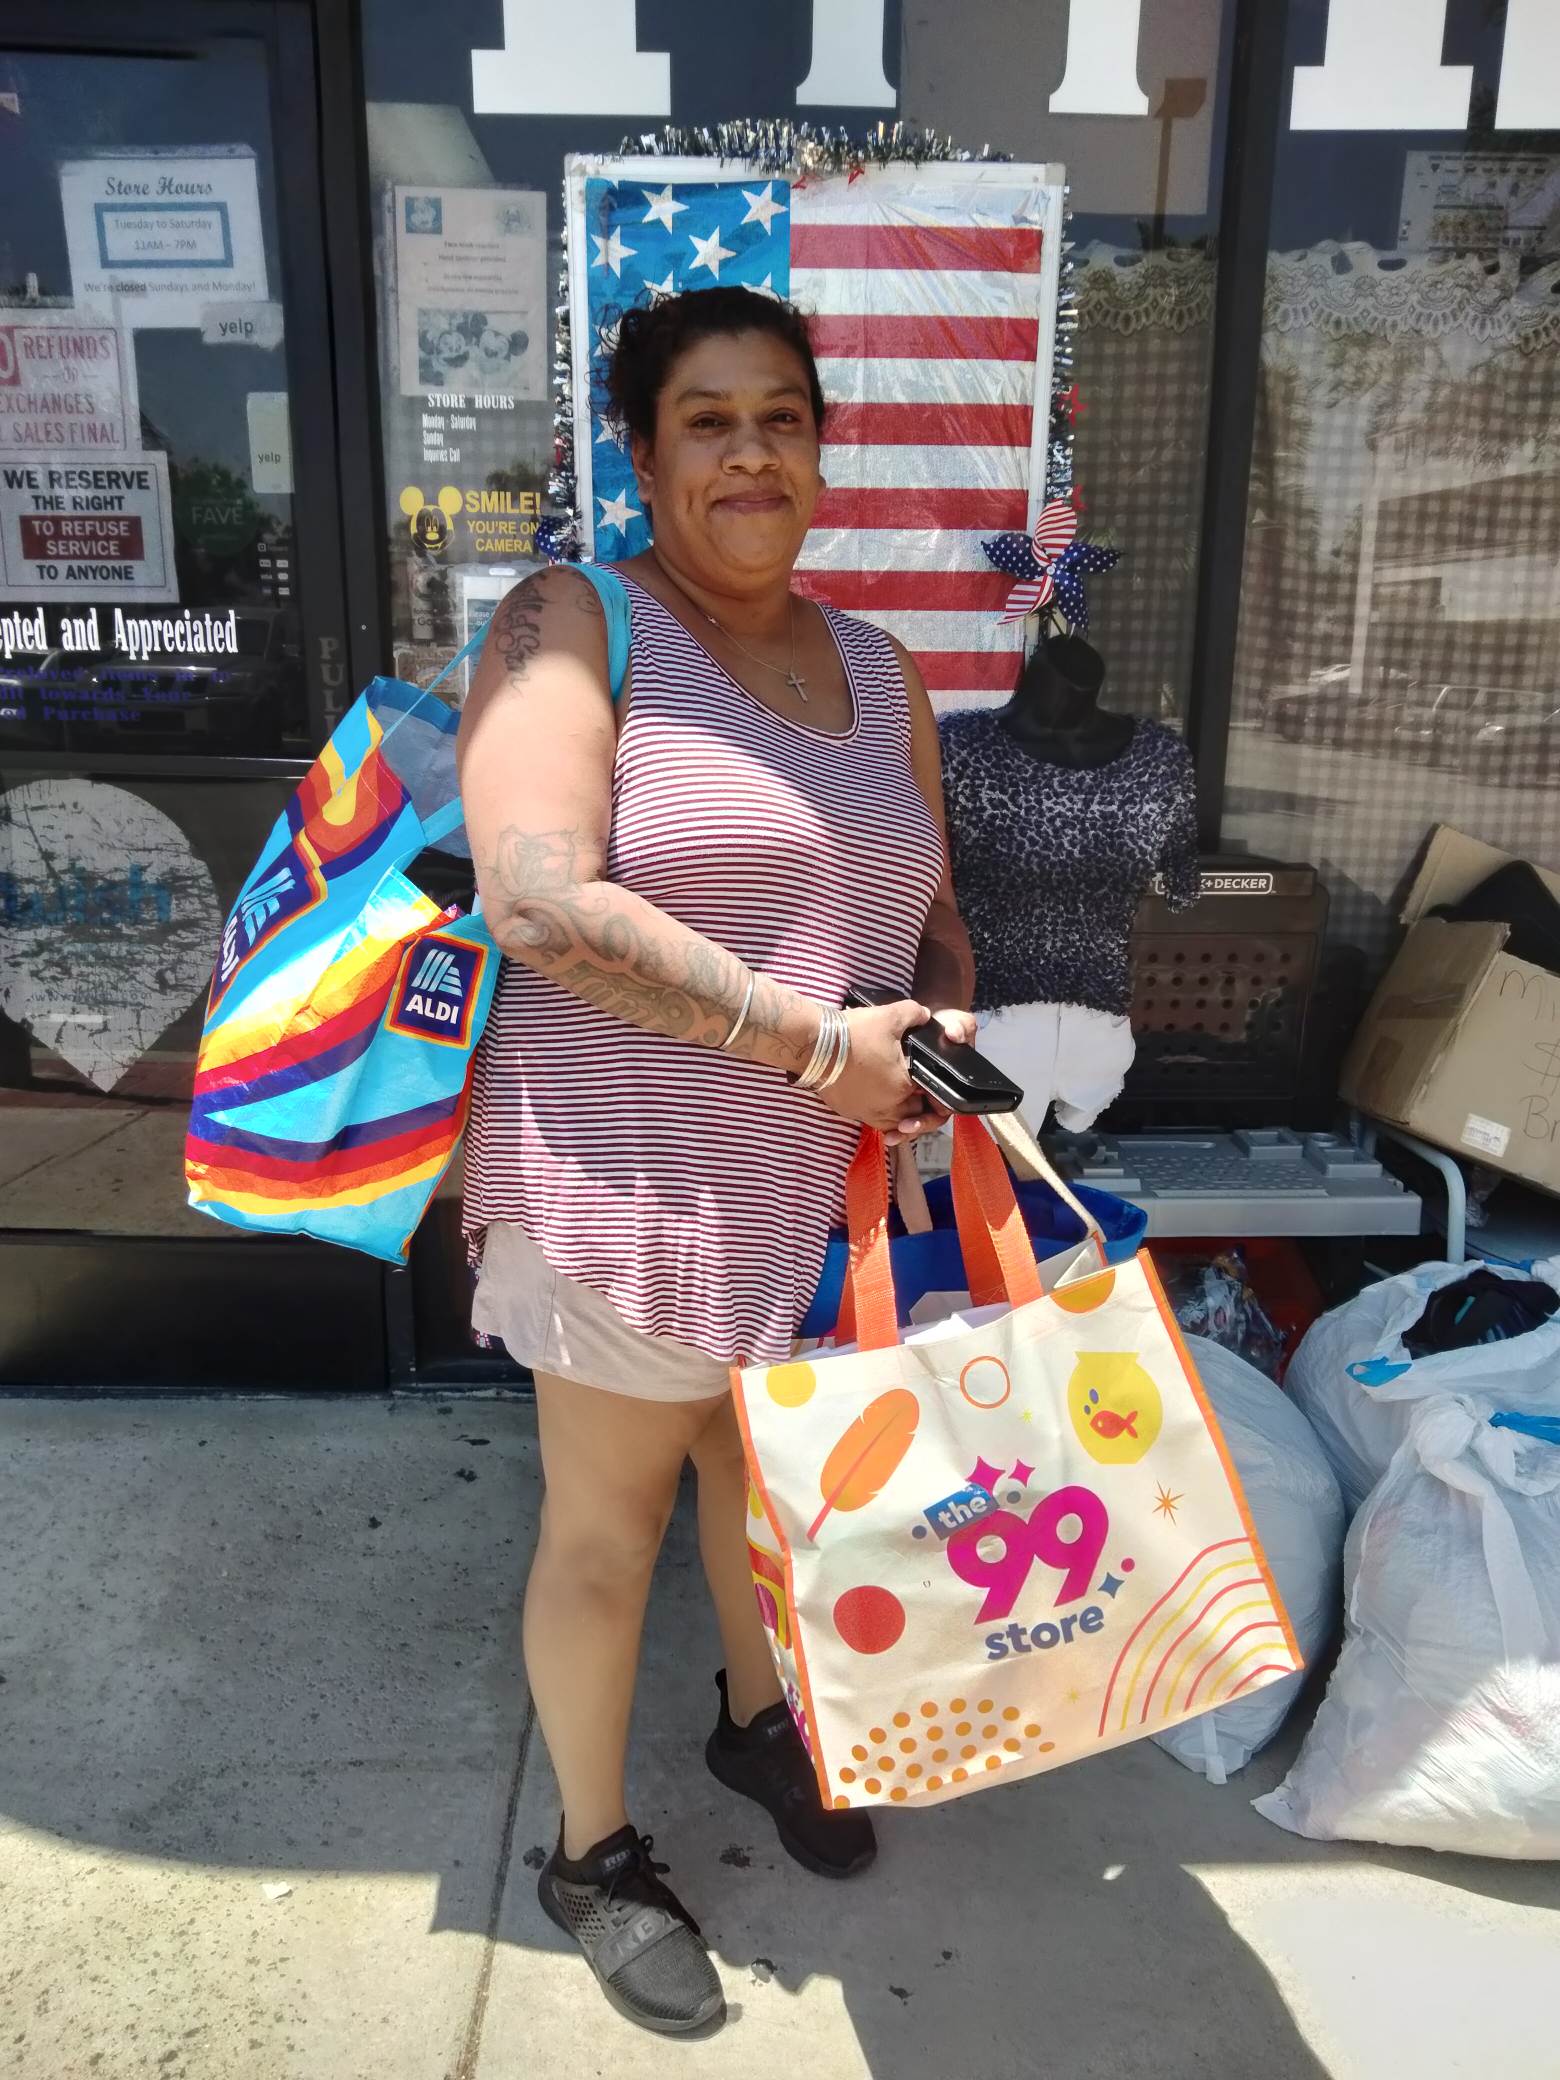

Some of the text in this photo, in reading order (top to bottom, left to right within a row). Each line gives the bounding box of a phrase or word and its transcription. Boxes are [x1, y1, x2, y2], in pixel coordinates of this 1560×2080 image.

[104, 176, 213, 196] Store Hours
[114, 219, 213, 231] Tuesday to Saturday
[134, 240, 164, 251] 11AM
[175, 240, 198, 250] 7PM
[116, 282, 147, 292] closed
[191, 281, 210, 292] and
[219, 318, 255, 337] yelp
[23, 335, 111, 360] REFUNDS
[427, 393, 516, 410] STORE HOURS
[422, 413, 445, 432] Monday
[13, 422, 120, 444] SALES FINAL
[422, 430, 445, 447] Sunday
[257, 452, 282, 464] yelp
[3, 470, 151, 490] WE RESERVE
[31, 495, 126, 511] THE RIGHT
[465, 490, 541, 514] SMILE!
[191, 506, 243, 526] FAVE
[31, 520, 131, 537] TO REFUSE
[467, 520, 540, 535] YOU'RE ON
[46, 540, 121, 556] SERVICE
[475, 538, 533, 553] CAMERA
[36, 564, 135, 580] TO ANYONE
[0, 606, 239, 660] pted and Appreciated
[405, 995, 460, 1025] ALDI
[938, 1496, 987, 1529] the
[946, 1485, 1109, 1626] 99
[984, 1605, 1105, 1661] store
